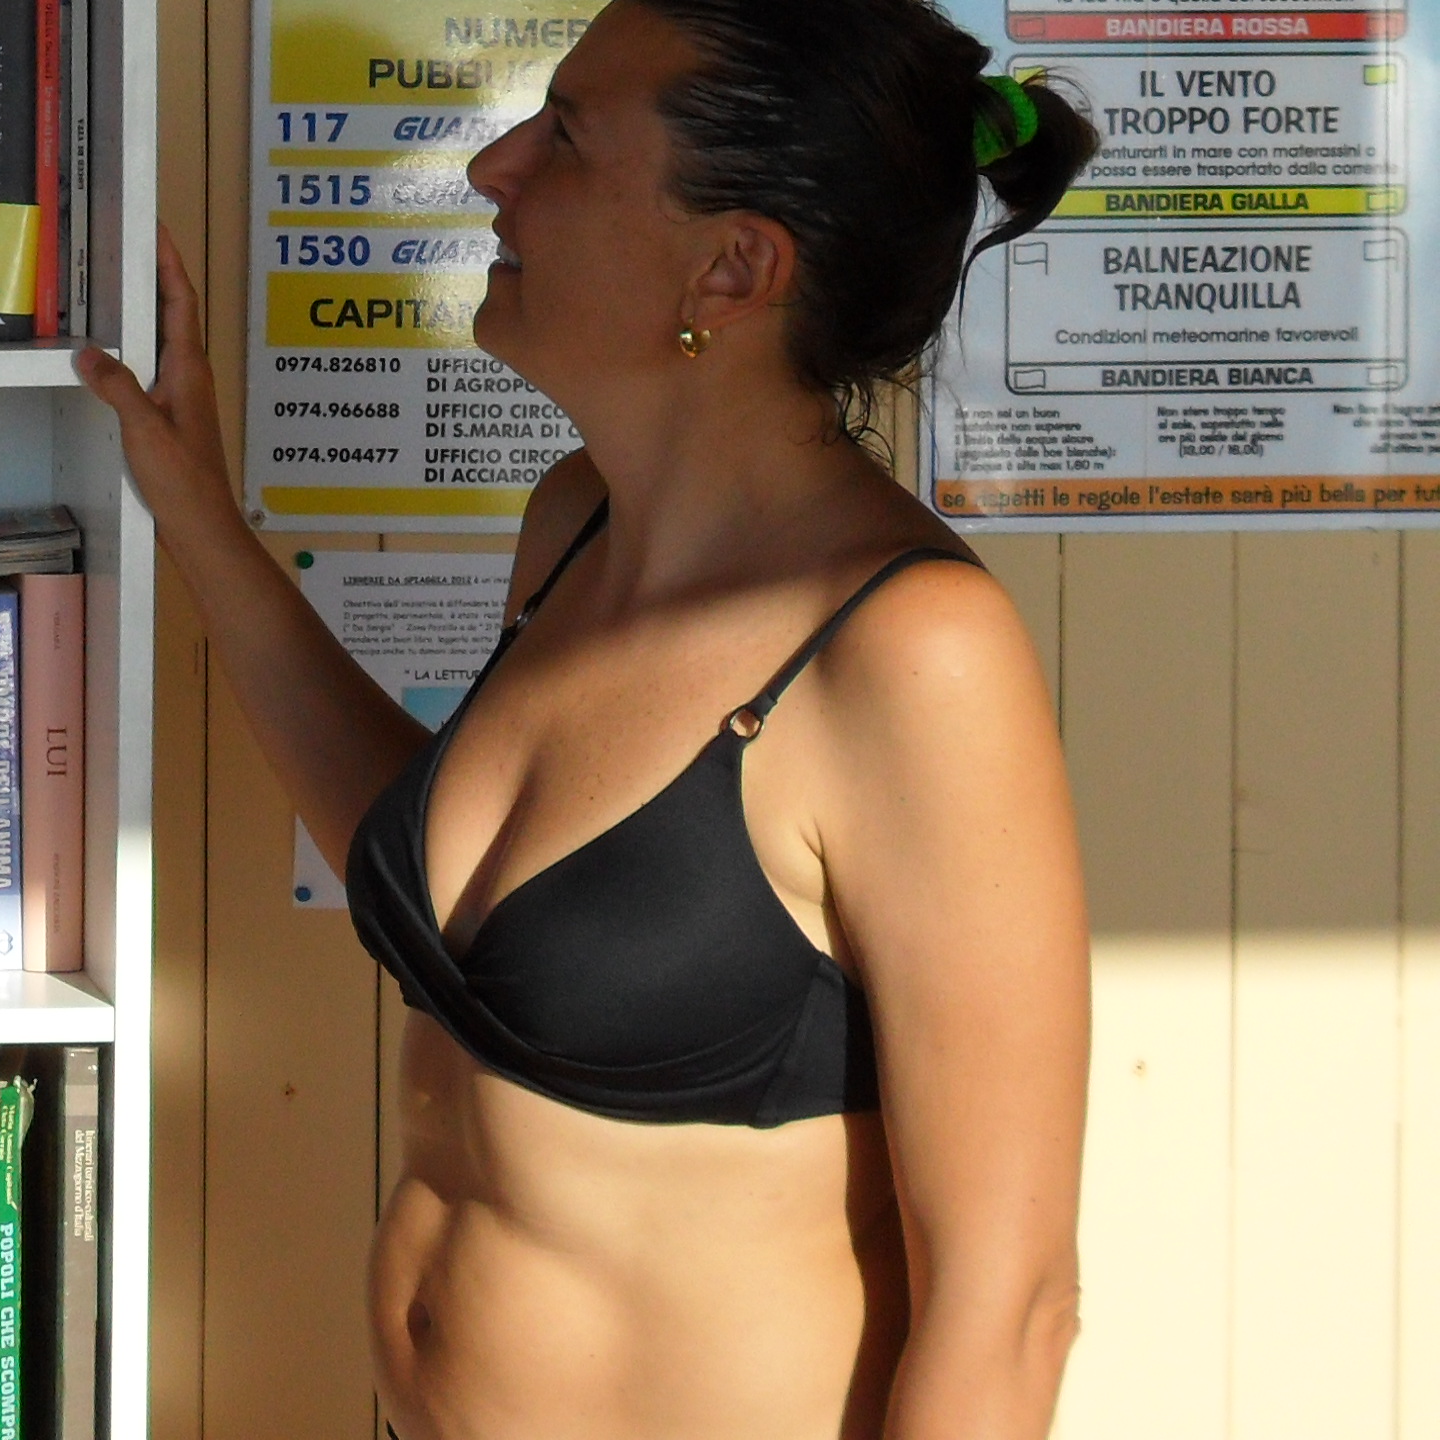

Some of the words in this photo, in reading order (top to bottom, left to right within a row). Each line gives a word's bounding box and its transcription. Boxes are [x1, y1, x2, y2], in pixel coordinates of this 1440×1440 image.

[444, 17, 592, 48] NUMER
[1106, 19, 1225, 37] BANDIERA
[1232, 18, 1310, 37] ROSSA
[1139, 71, 1165, 97] IL
[1176, 70, 1276, 97] VENTO
[277, 112, 349, 143] 117
[1104, 107, 1230, 135] TROPPO
[1242, 106, 1340, 134] FORTE
[277, 174, 372, 205] 1515
[1105, 194, 1224, 211] BANDIERA
[1231, 193, 1310, 211] GIALLA
[275, 235, 371, 266] 1530
[1103, 245, 1313, 274] BALNEAZIONE
[1114, 282, 1301, 313] TRANQUILLA
[1055, 328, 1147, 344] Condizioni
[1152, 329, 1270, 343] meteomarine
[1275, 327, 1359, 343] favorevoli
[275, 357, 401, 373] 0974.826810
[426, 358, 504, 374] UFFICIO
[1101, 368, 1219, 387] BANDIERA
[1227, 367, 1314, 387] BIANCA
[425, 377, 447, 393] DI
[274, 402, 400, 418] 0974.966688
[425, 403, 503, 419] UFFICIO
[425, 422, 447, 438] DI
[452, 422, 534, 439] S.MARIA
[541, 423, 562, 439] DI
[272, 448, 399, 464] 0974.904477
[425, 448, 502, 465] UFFICIO
[424, 467, 446, 483] DI
[46, 727, 67, 778] LUI
[0, 1222, 15, 1300] POPOLI
[0, 1307, 15, 1349] CHE
